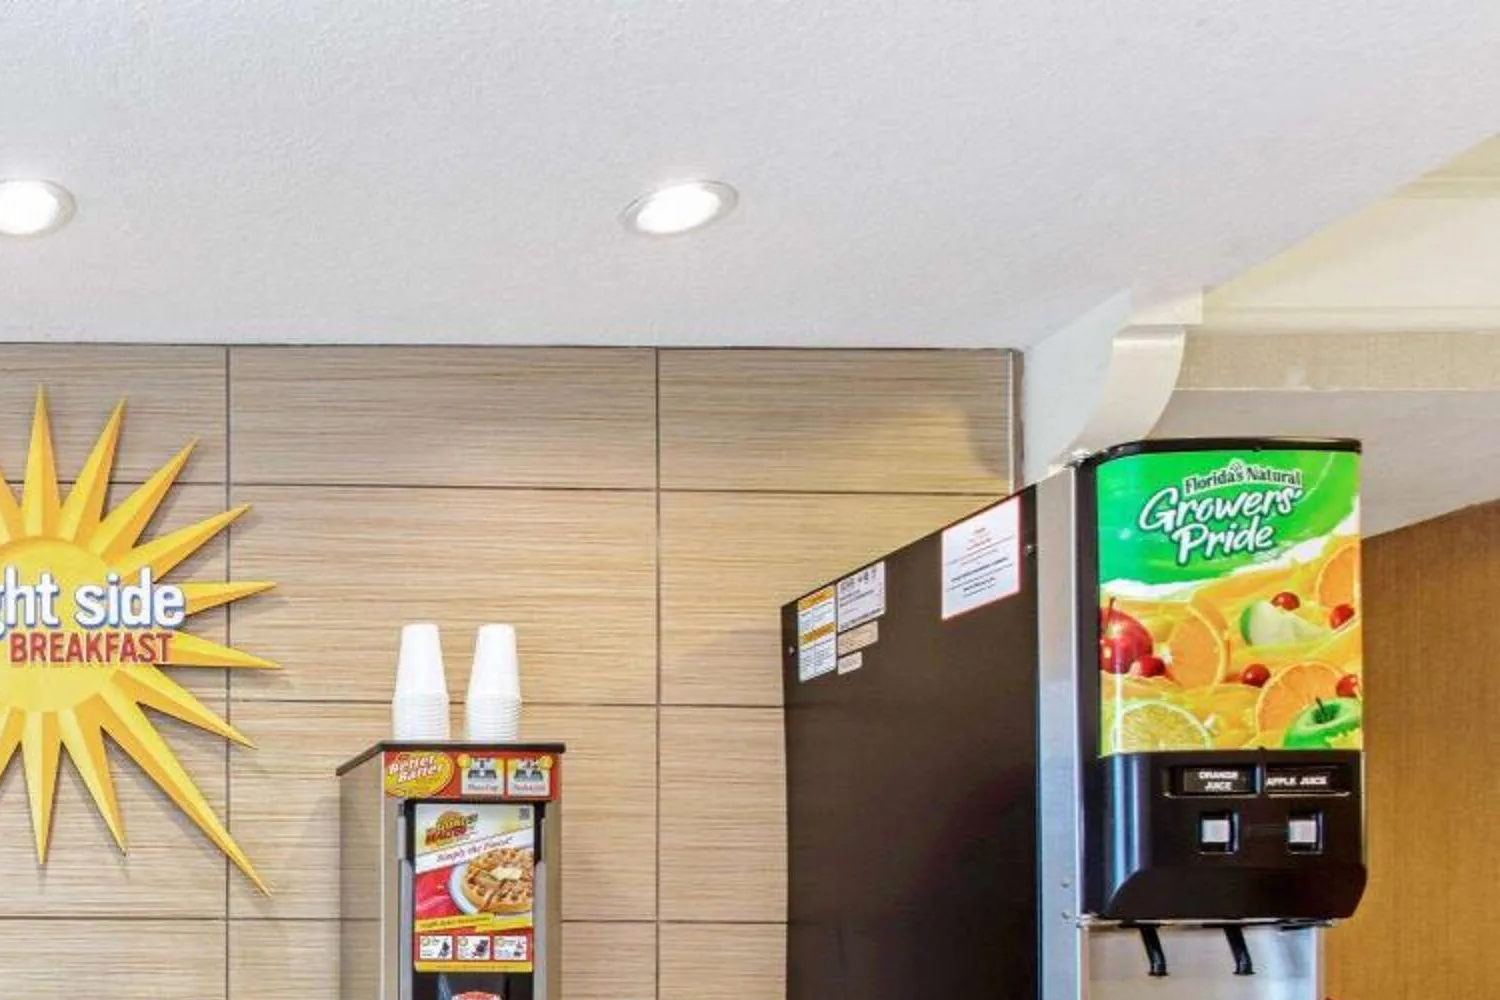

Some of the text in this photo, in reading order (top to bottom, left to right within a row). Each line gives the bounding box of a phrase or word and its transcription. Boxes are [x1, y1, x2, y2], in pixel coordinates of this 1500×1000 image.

[1184, 467, 1302, 495] Florida's Natural
[1171, 514, 1275, 565] Pride
[75, 567, 186, 628] side
[9, 631, 174, 665] BREAKFAST
[1198, 771, 1240, 781] ORANGE
[1204, 781, 1233, 792] JUICE
[1265, 776, 1328, 787] APPLE JUICE
